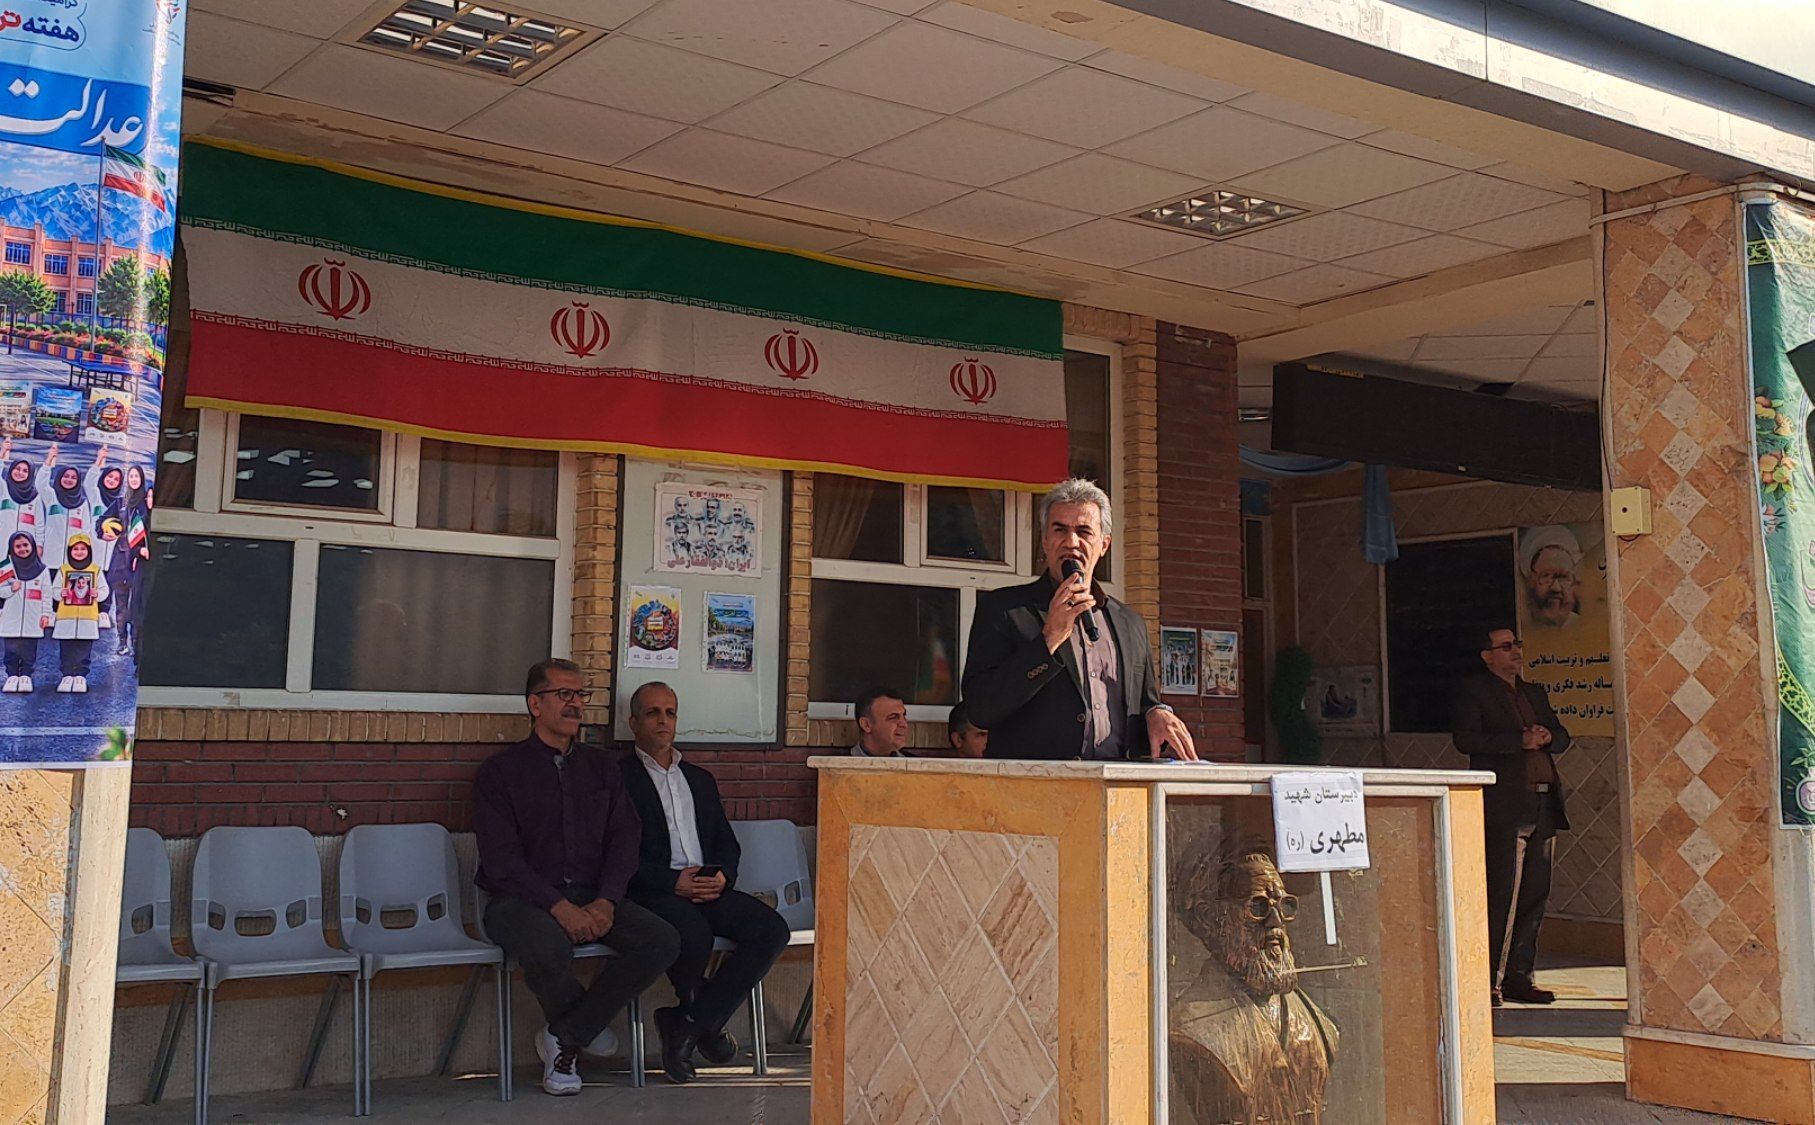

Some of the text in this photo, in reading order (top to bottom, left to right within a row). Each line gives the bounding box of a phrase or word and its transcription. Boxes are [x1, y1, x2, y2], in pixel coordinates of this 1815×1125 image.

[22, 16, 80, 42] هفته
[0, 77, 144, 147] عدالت
[1528, 652, 1610, 668] تعلیم و تربیت اسلامی
[1553, 677, 1574, 693] فکری
[1576, 679, 1592, 692] رشد
[1560, 704, 1578, 715] داده
[1579, 703, 1604, 718] فراوان
[1284, 786, 1358, 804] دبیرستان شهید
[1310, 822, 1365, 854] مطهری
